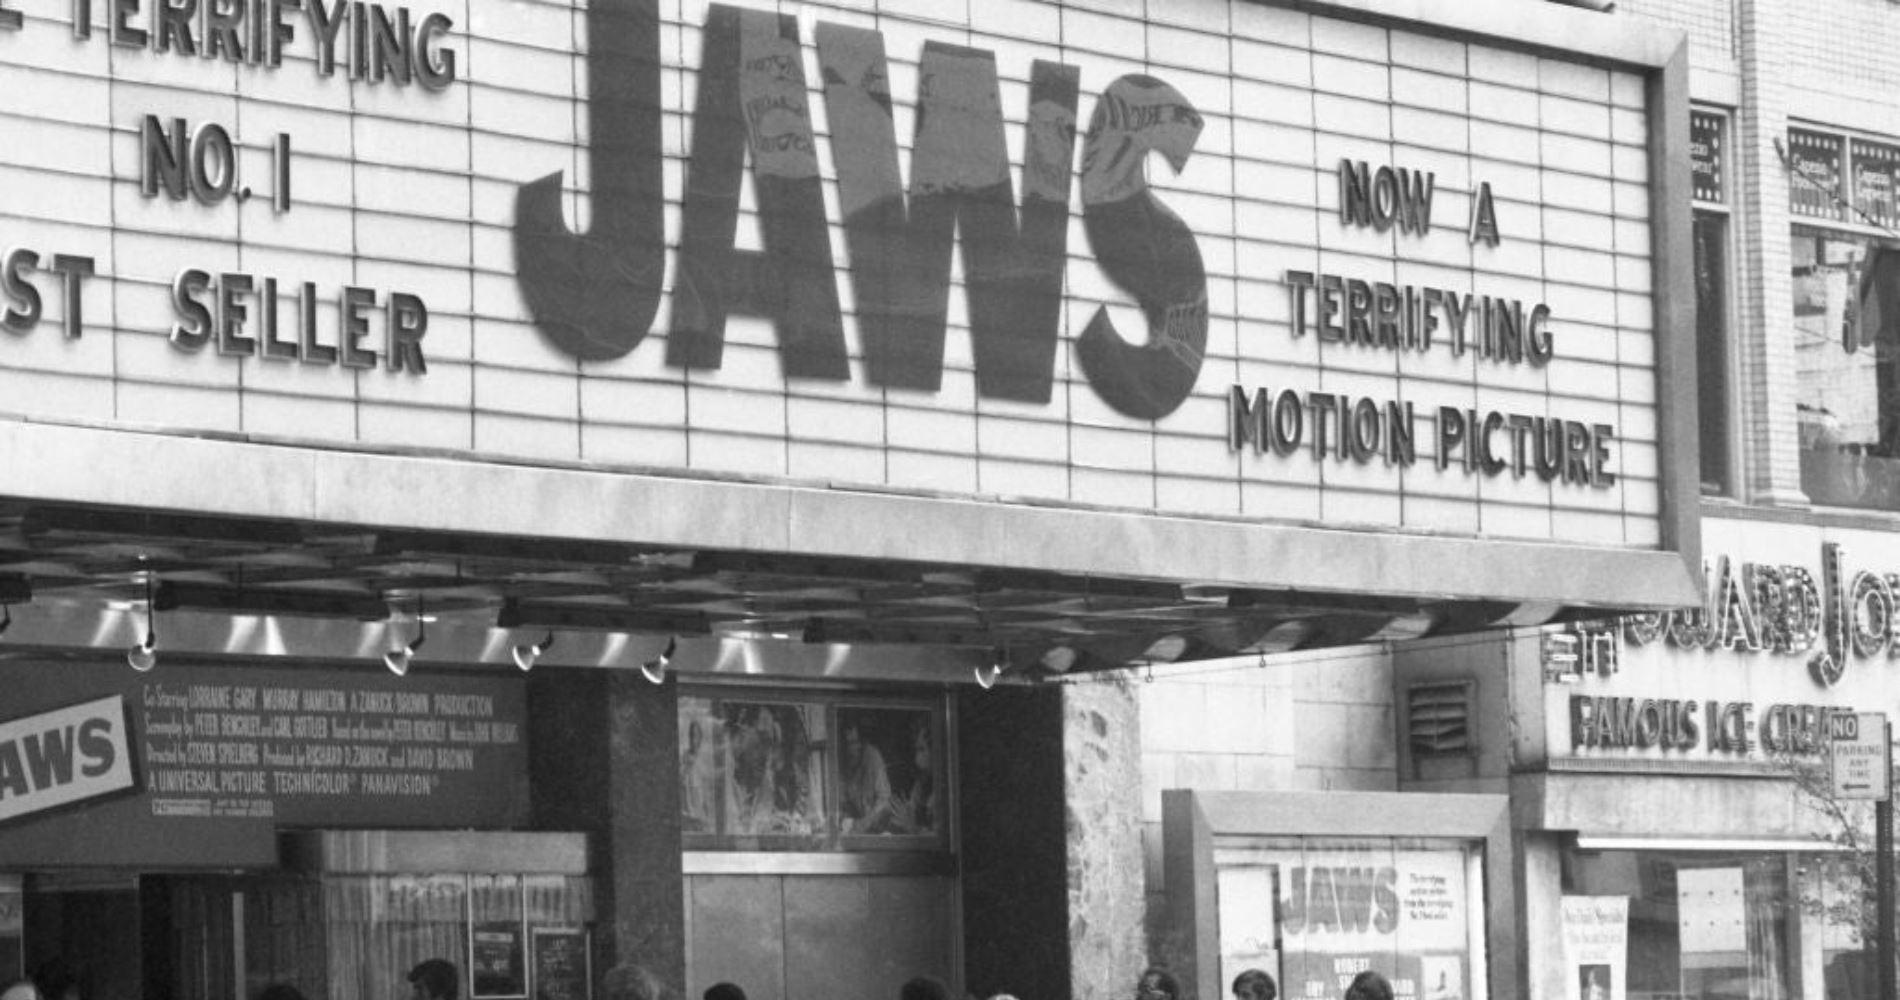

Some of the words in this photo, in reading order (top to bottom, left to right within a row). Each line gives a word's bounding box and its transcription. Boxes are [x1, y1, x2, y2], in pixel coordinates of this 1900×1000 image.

[140, 113, 252, 206] NO.
[1339, 158, 1435, 237] NOW
[1468, 181, 1501, 247] A
[514, 0, 1208, 420] JAWS
[1, 247, 96, 339] ST
[169, 268, 428, 375] SELLER
[1283, 268, 1554, 368] TERRIFYING
[1228, 384, 1416, 467] MOTION
[1435, 405, 1616, 489] PICTURE
[0, 717, 116, 801] AWS
[1570, 694, 1700, 754] FAMOUS
[1704, 699, 1755, 754] ICE
[1833, 716, 1858, 737] NO
[147, 771, 157, 793] A
[159, 770, 220, 793] UNIVERSAL
[220, 771, 265, 793] PICTURE
[1281, 866, 1399, 935] JAWS
